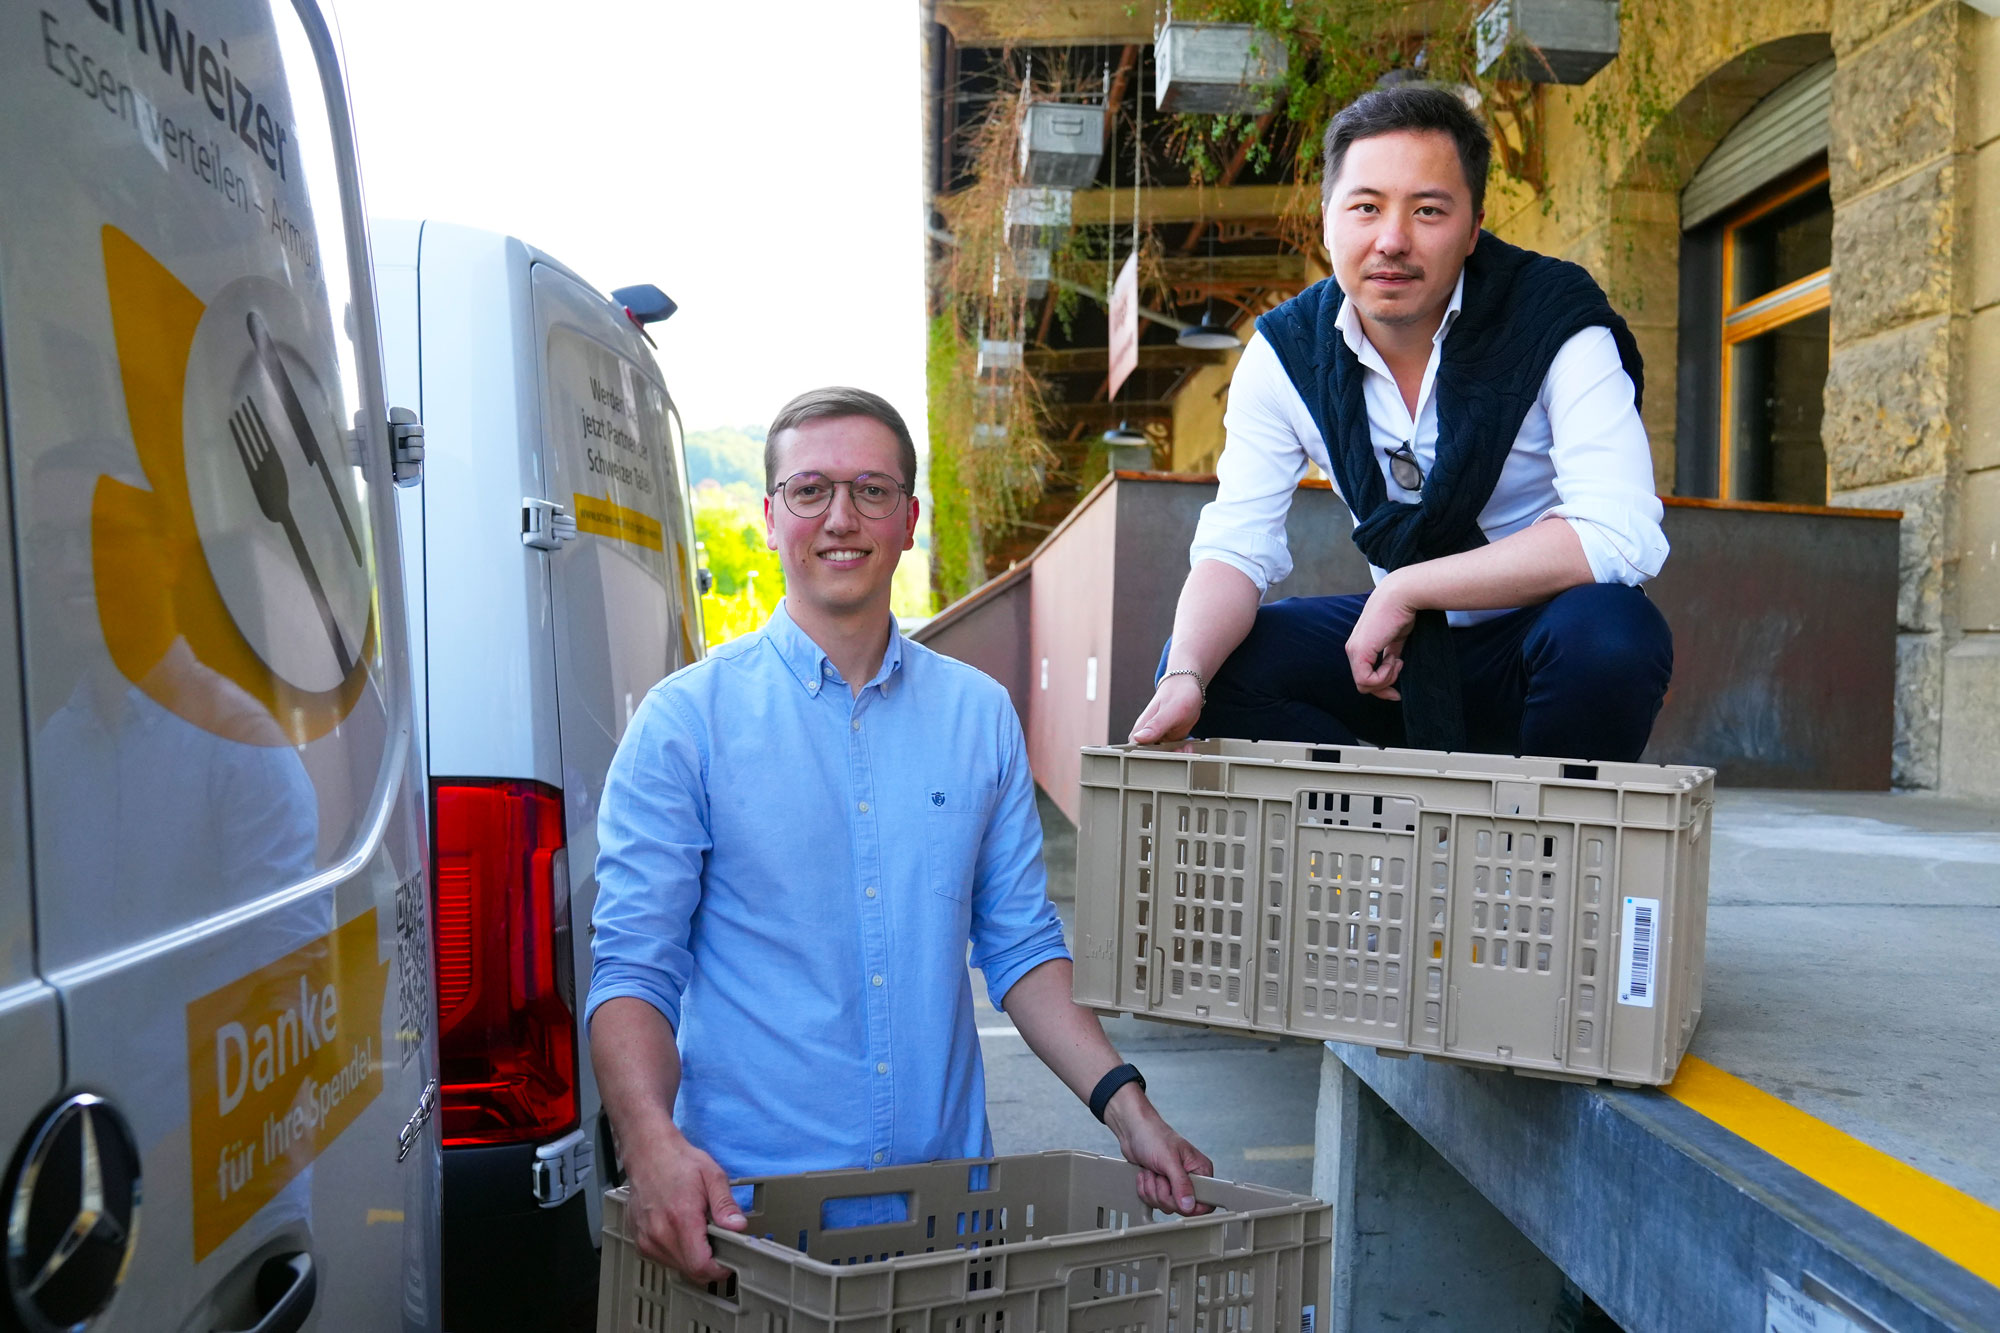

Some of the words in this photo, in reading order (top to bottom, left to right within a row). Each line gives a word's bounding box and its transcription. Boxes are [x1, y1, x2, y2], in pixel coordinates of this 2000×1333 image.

[40, 9, 139, 131] Essen
[144, 101, 249, 215] verteilen
[581, 408, 606, 439] jetzt
[587, 447, 633, 487] Schweizer
[216, 973, 338, 1118] Danke
[217, 1138, 256, 1201] für
[263, 1106, 303, 1167] Ihre
[306, 1037, 373, 1131] Spende!
[1789, 1295, 1817, 1328] Tafel
